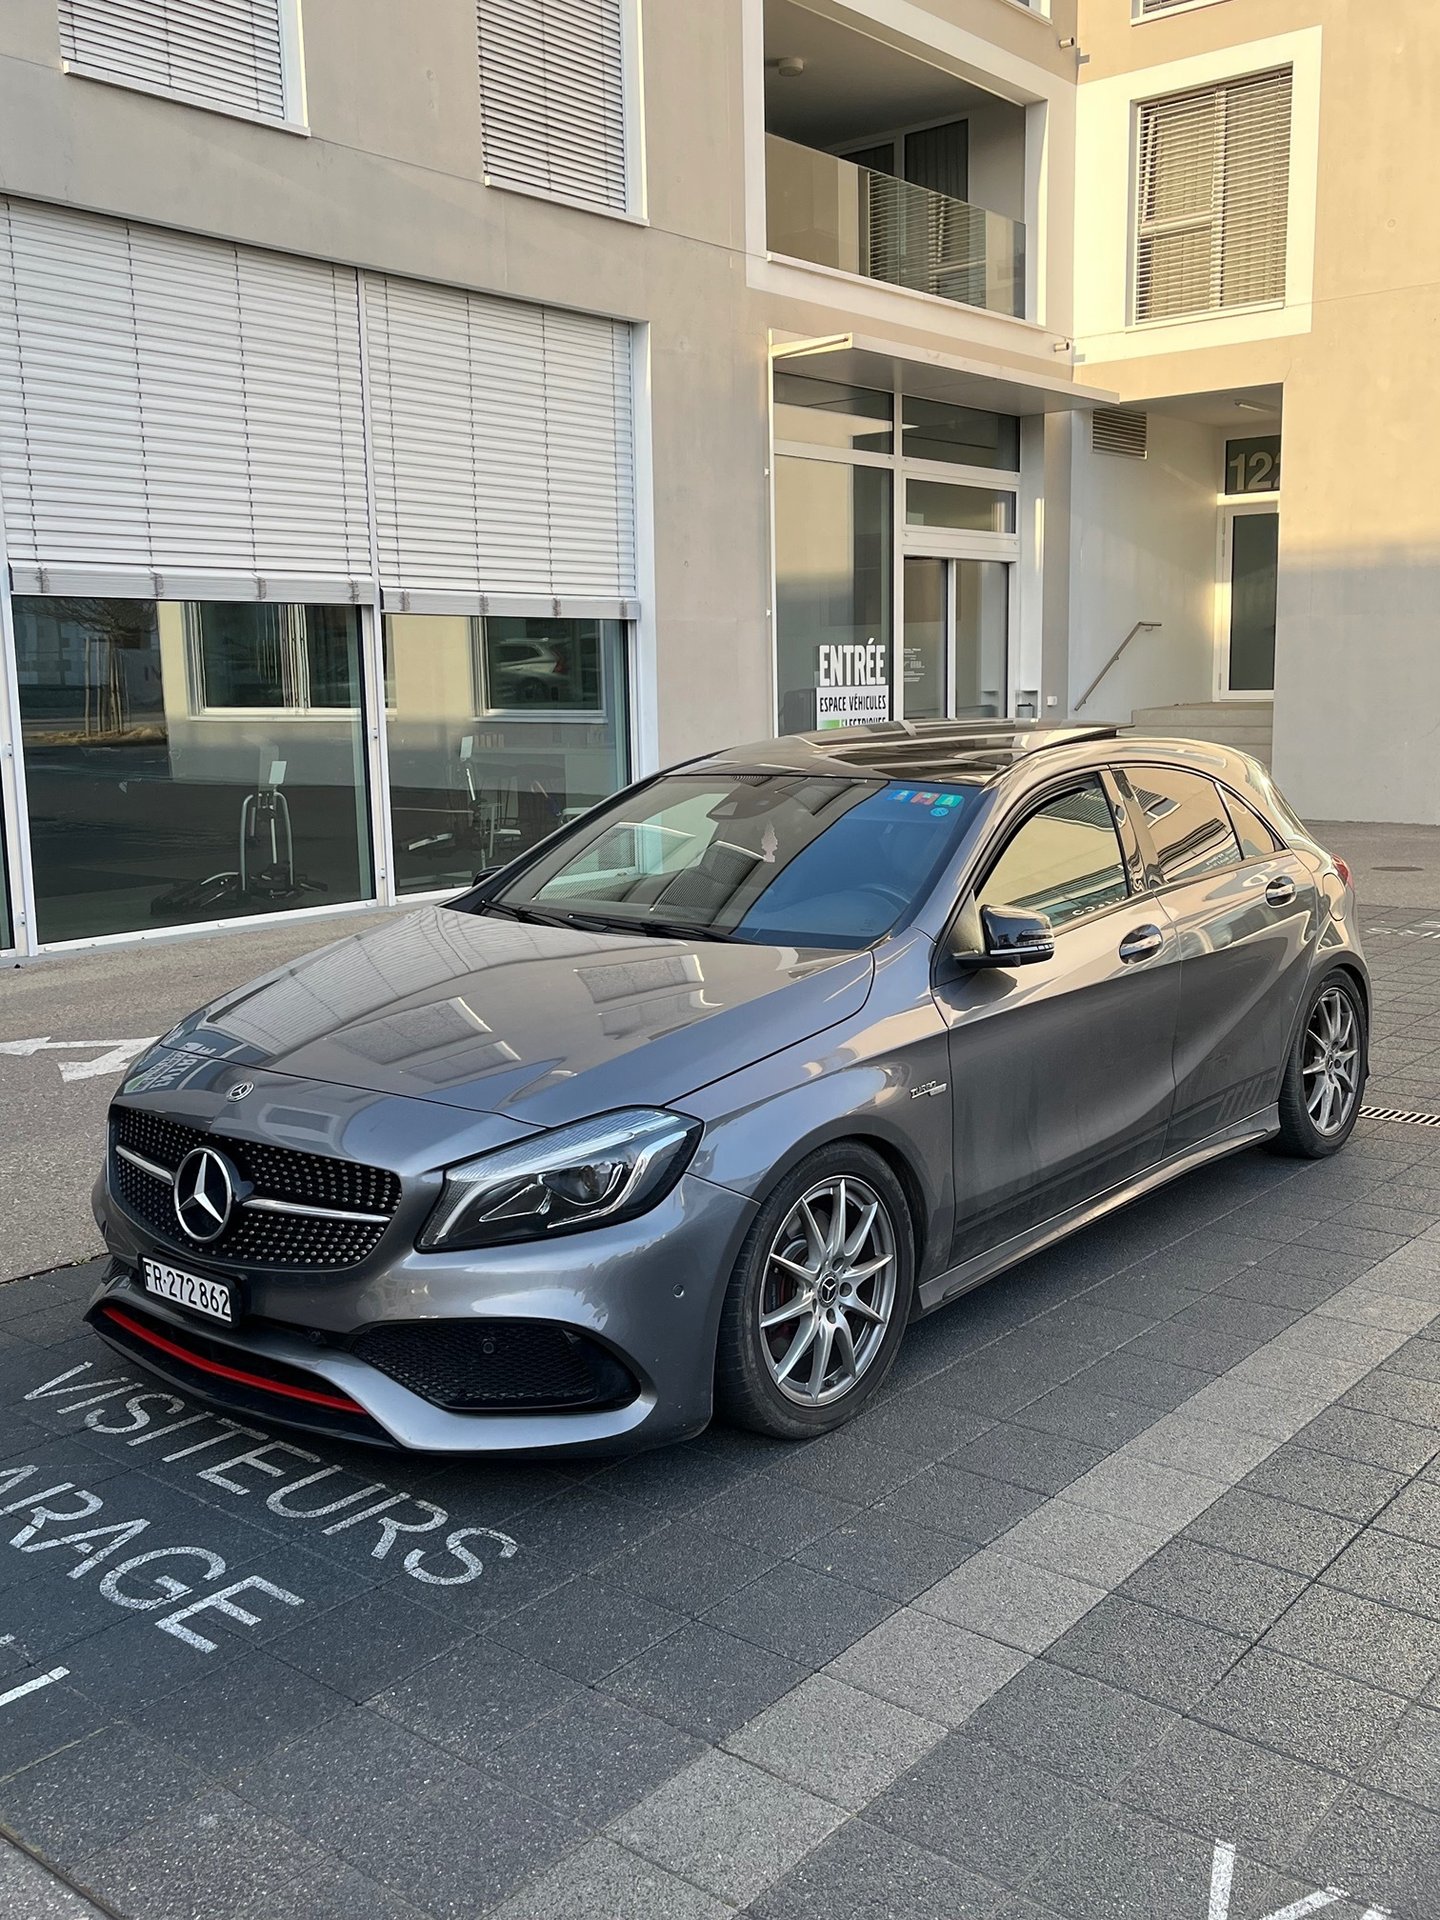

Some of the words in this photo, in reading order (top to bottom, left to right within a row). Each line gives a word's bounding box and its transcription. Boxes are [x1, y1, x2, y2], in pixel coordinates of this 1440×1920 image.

[819, 638, 886, 687] ENTRÉE
[819, 696, 847, 713] ESPACE
[849, 693, 887, 711] VÉHICULES
[24, 1361, 518, 1586] VISITEURS
